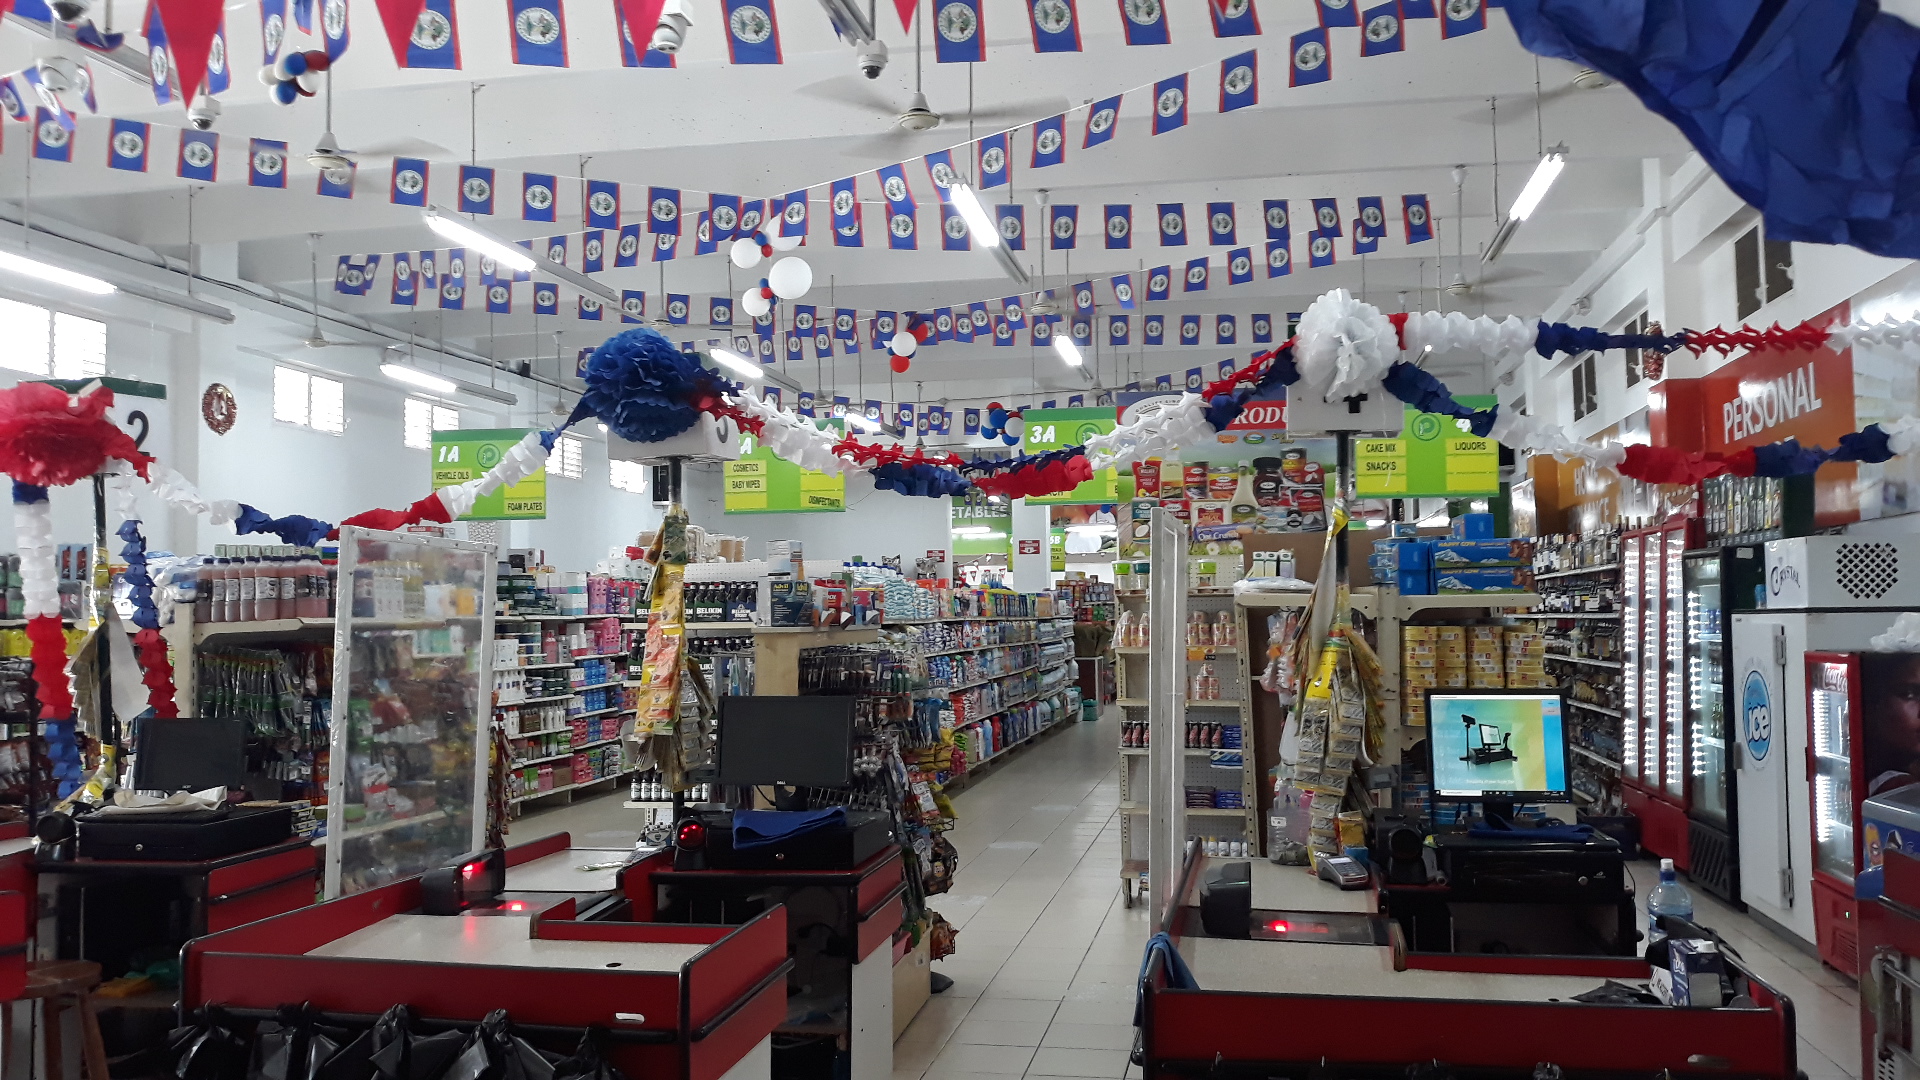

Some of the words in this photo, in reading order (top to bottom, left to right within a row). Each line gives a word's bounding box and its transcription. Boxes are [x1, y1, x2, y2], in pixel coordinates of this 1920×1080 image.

[1723, 362, 1822, 444] PERSONAL
[1029, 425, 1056, 444] 3A
[1365, 443, 1384, 453] CAKE
[1384, 443, 1397, 453] MIX
[1454, 441, 1487, 451] LIQUORS
[438, 445, 459, 463] 1A
[733, 463, 759, 473] COSMETICS
[1366, 461, 1397, 471] SNACKS
[435, 471, 457, 480] VEHICLE
[457, 471, 470, 480] OILS
[731, 480, 745, 489] BABY
[745, 479, 761, 489] WIPES
[507, 502, 522, 511] FOAM
[523, 502, 543, 511] PLATES
[808, 495, 841, 508] DISINFECTANTS
[696, 607, 723, 615] BELIKIN
